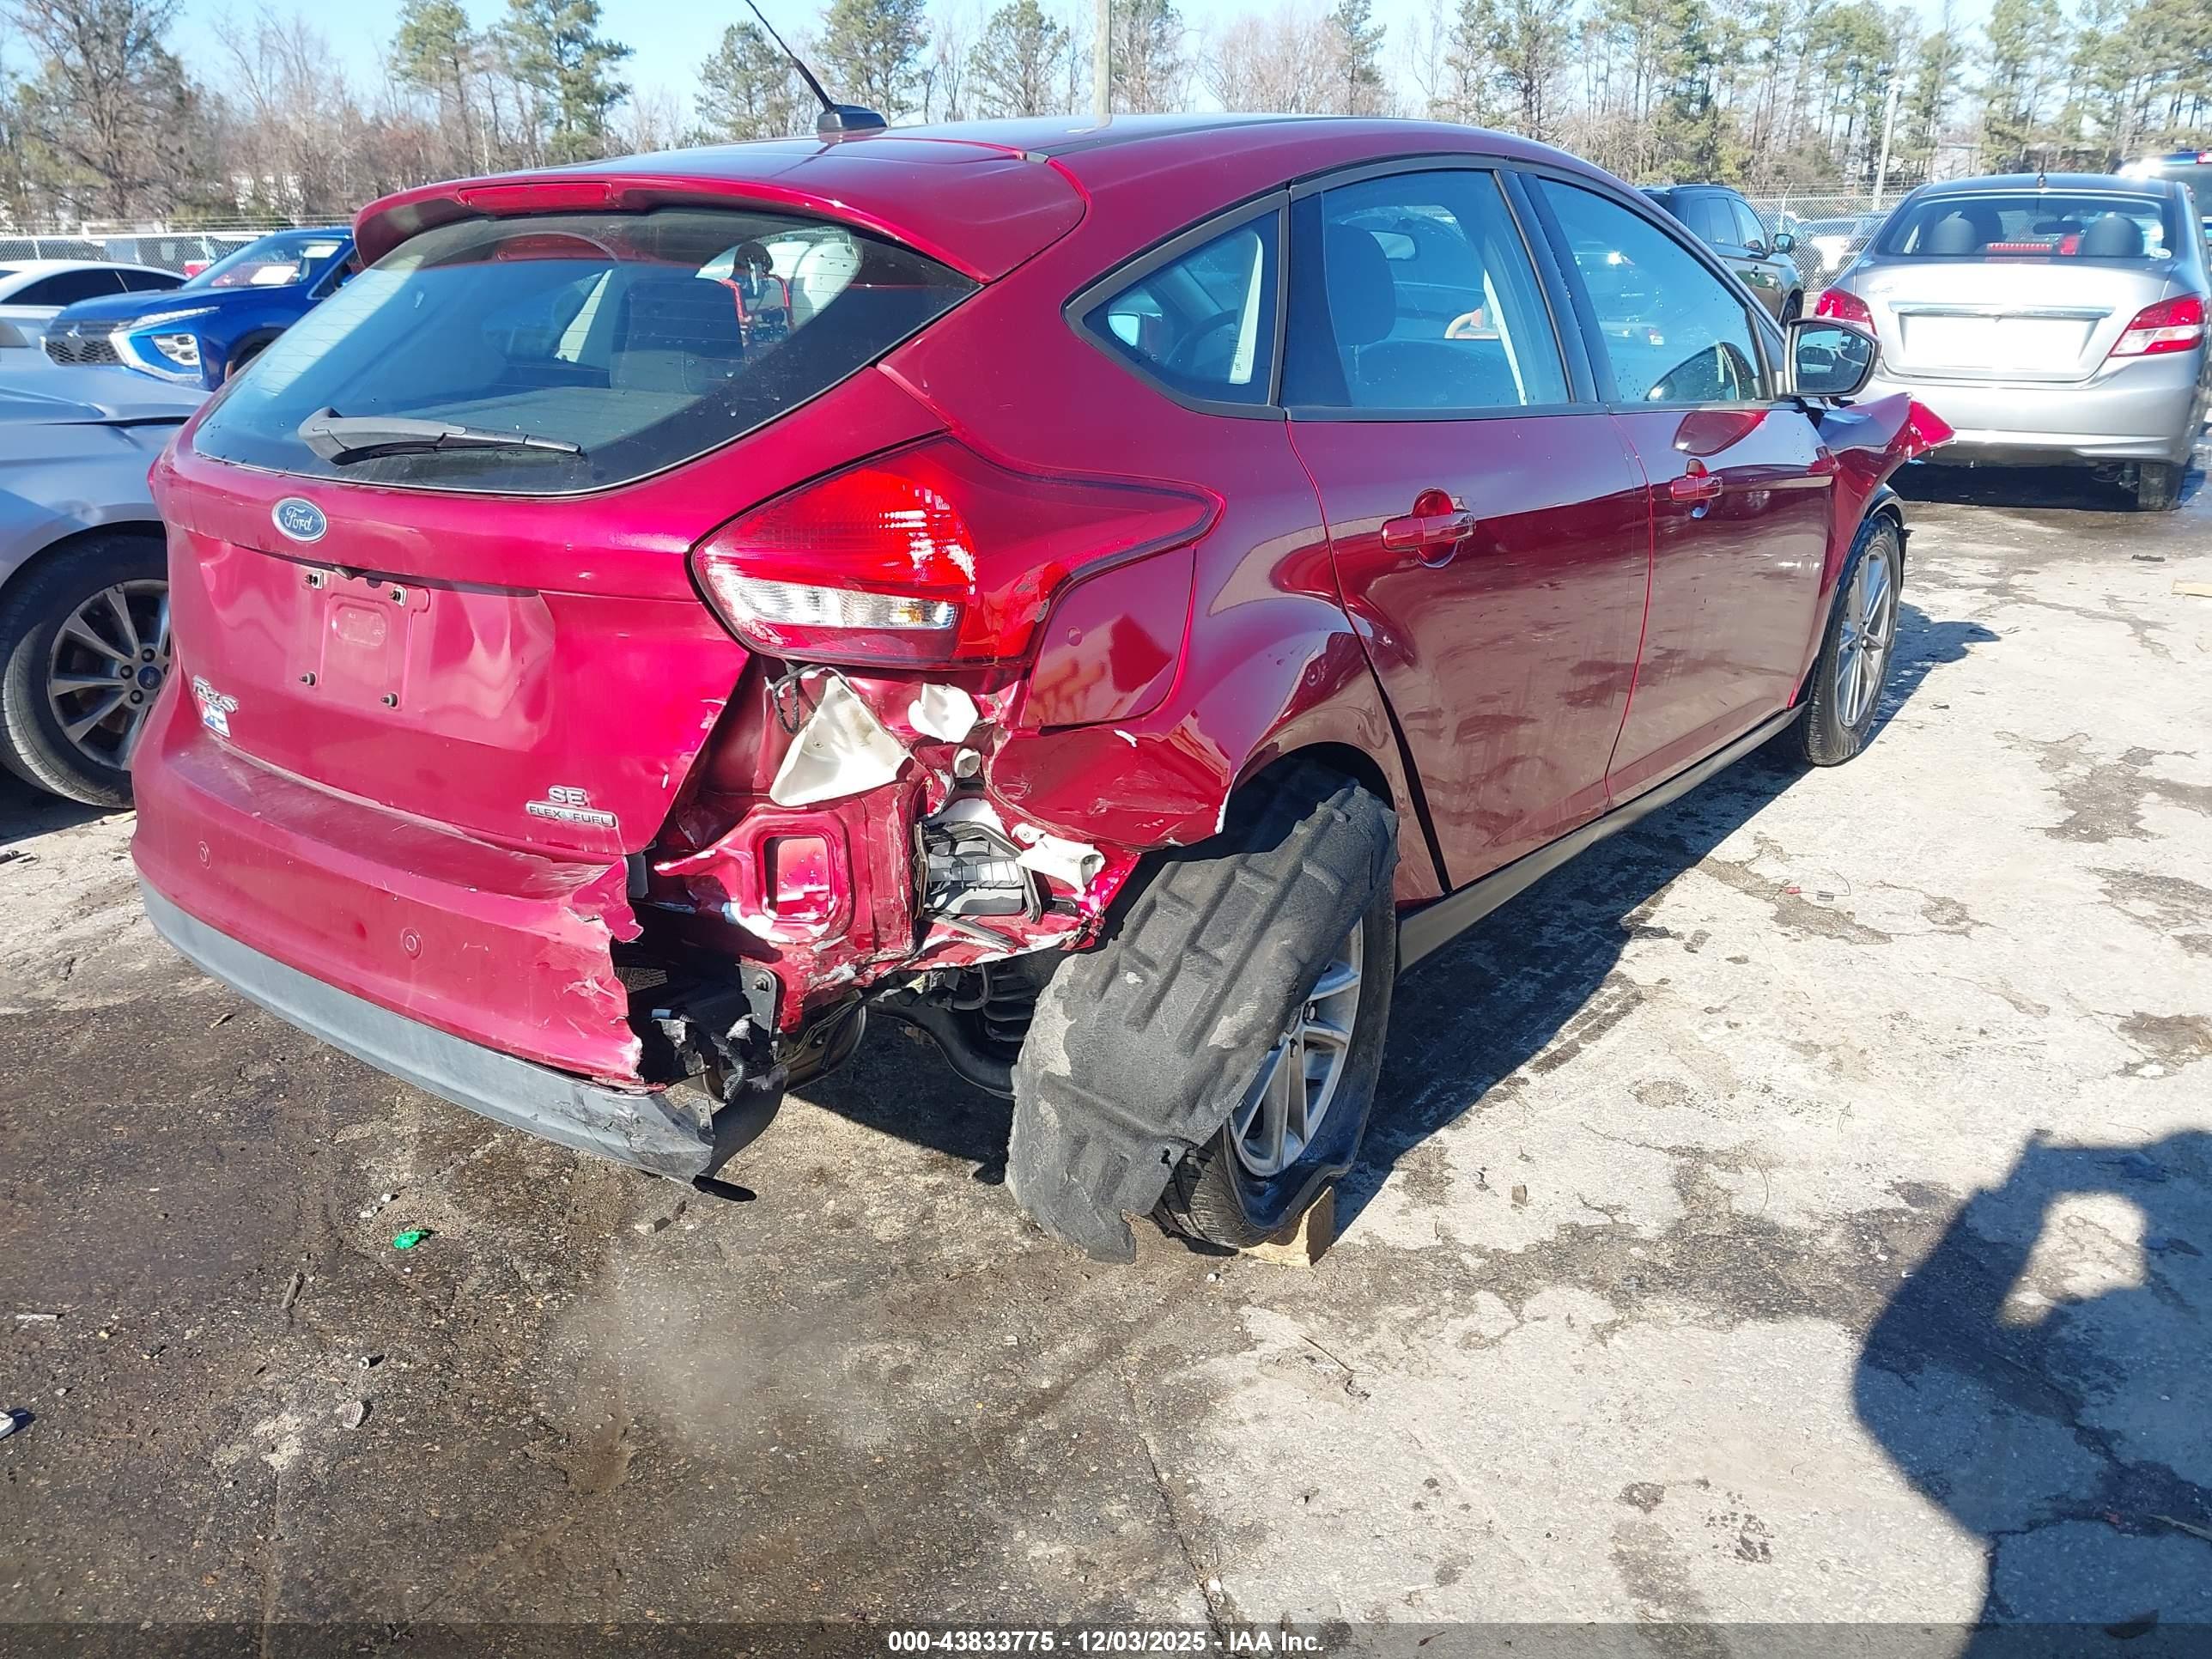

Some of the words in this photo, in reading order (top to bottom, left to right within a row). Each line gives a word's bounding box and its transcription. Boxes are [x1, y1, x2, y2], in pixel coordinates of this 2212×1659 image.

[284, 506, 313, 531] Ford
[550, 787, 588, 806] SE
[529, 805, 562, 818] FLEX
[572, 812, 612, 825] FUEL
